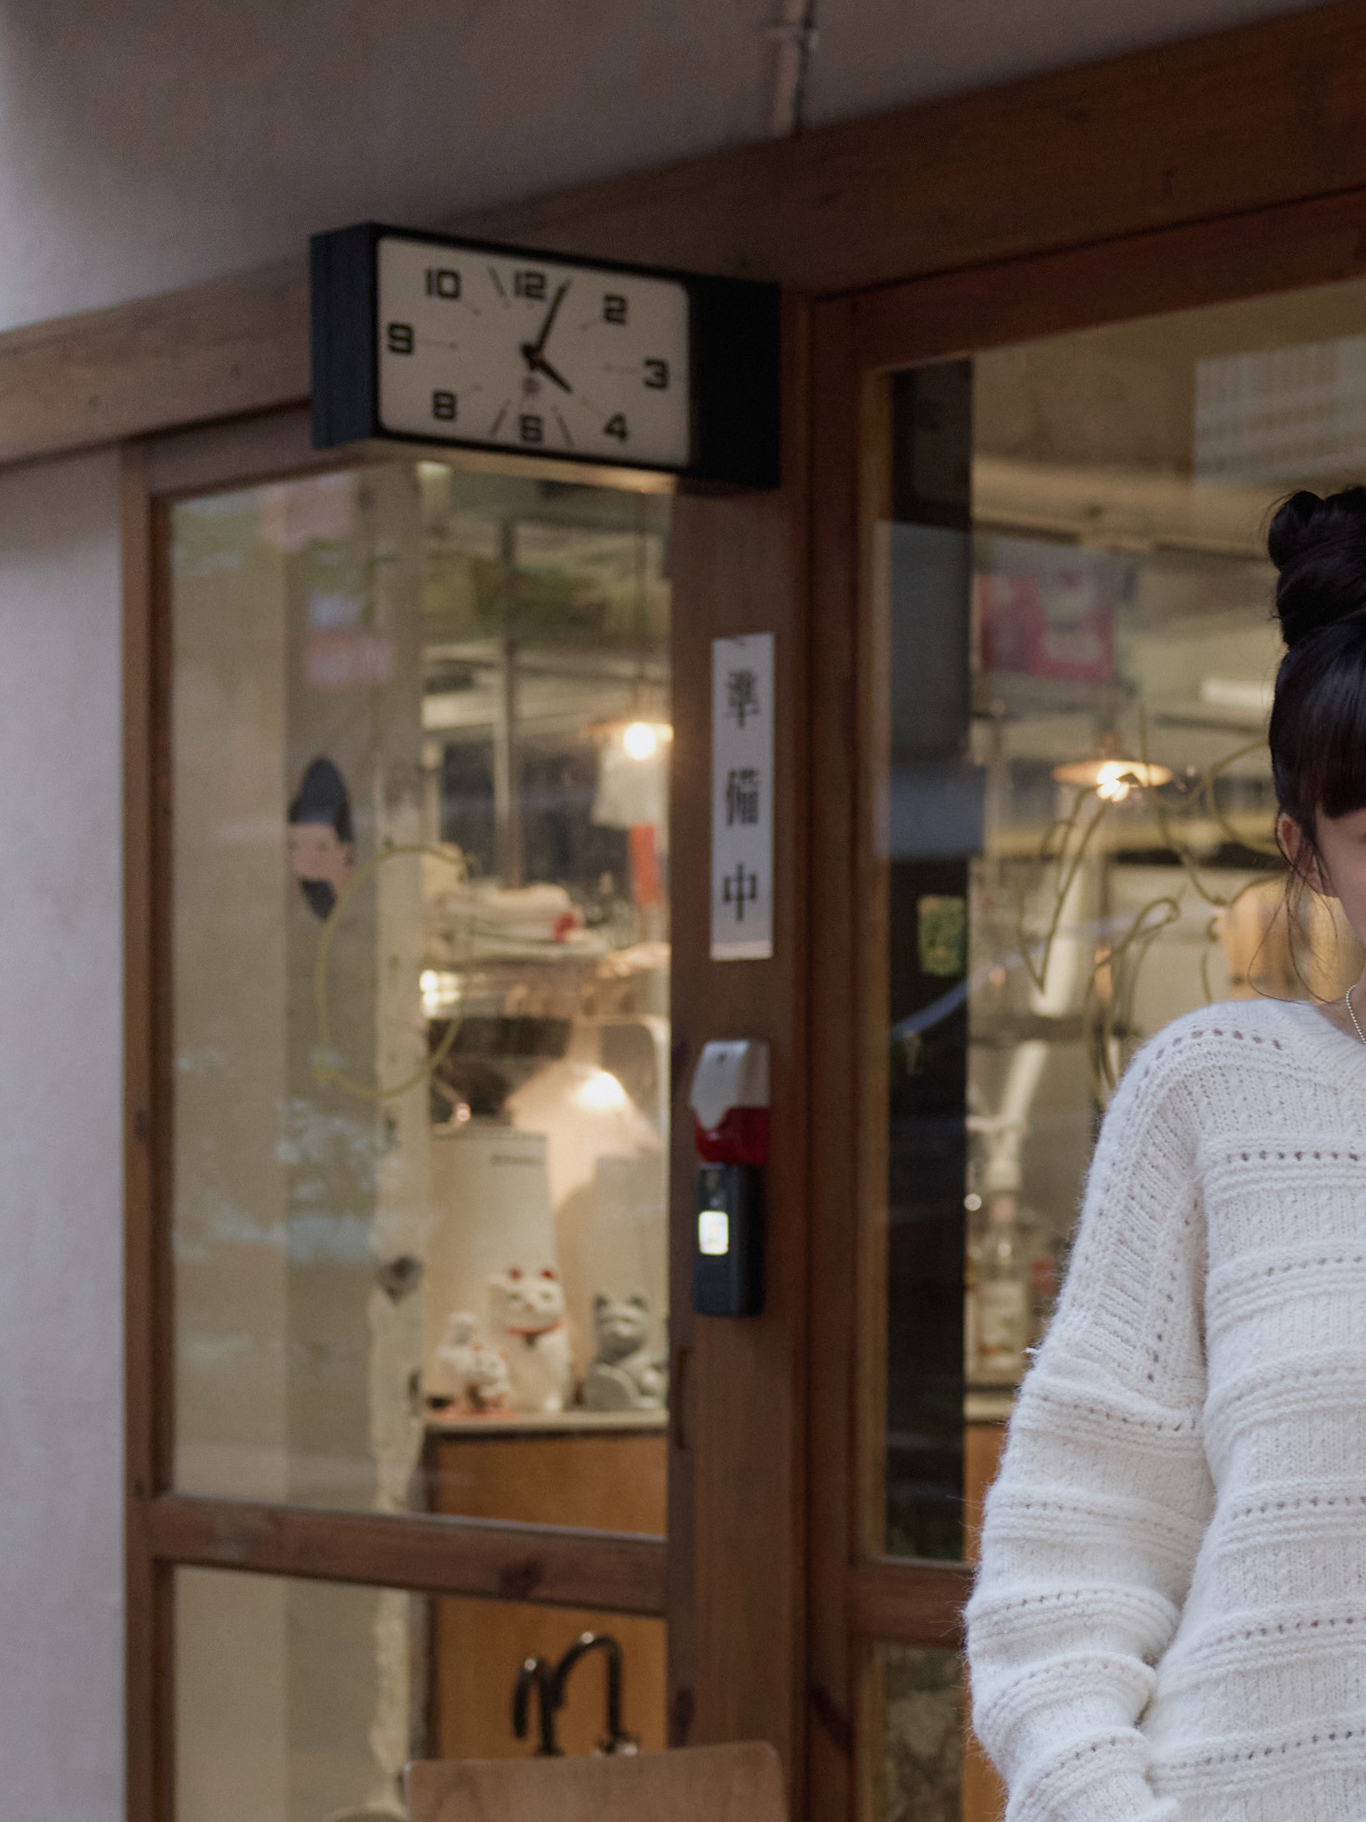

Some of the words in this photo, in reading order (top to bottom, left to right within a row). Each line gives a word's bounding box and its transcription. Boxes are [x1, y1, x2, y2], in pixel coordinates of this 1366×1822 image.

[425, 267, 461, 300] 10
[514, 270, 548, 301] 12
[604, 293, 628, 326] 2
[387, 322, 414, 355] 9
[643, 358, 669, 391] 3
[432, 390, 458, 421] 8
[519, 414, 543, 444] 6
[605, 412, 629, 443] 4
[724, 667, 761, 922] 準備中
